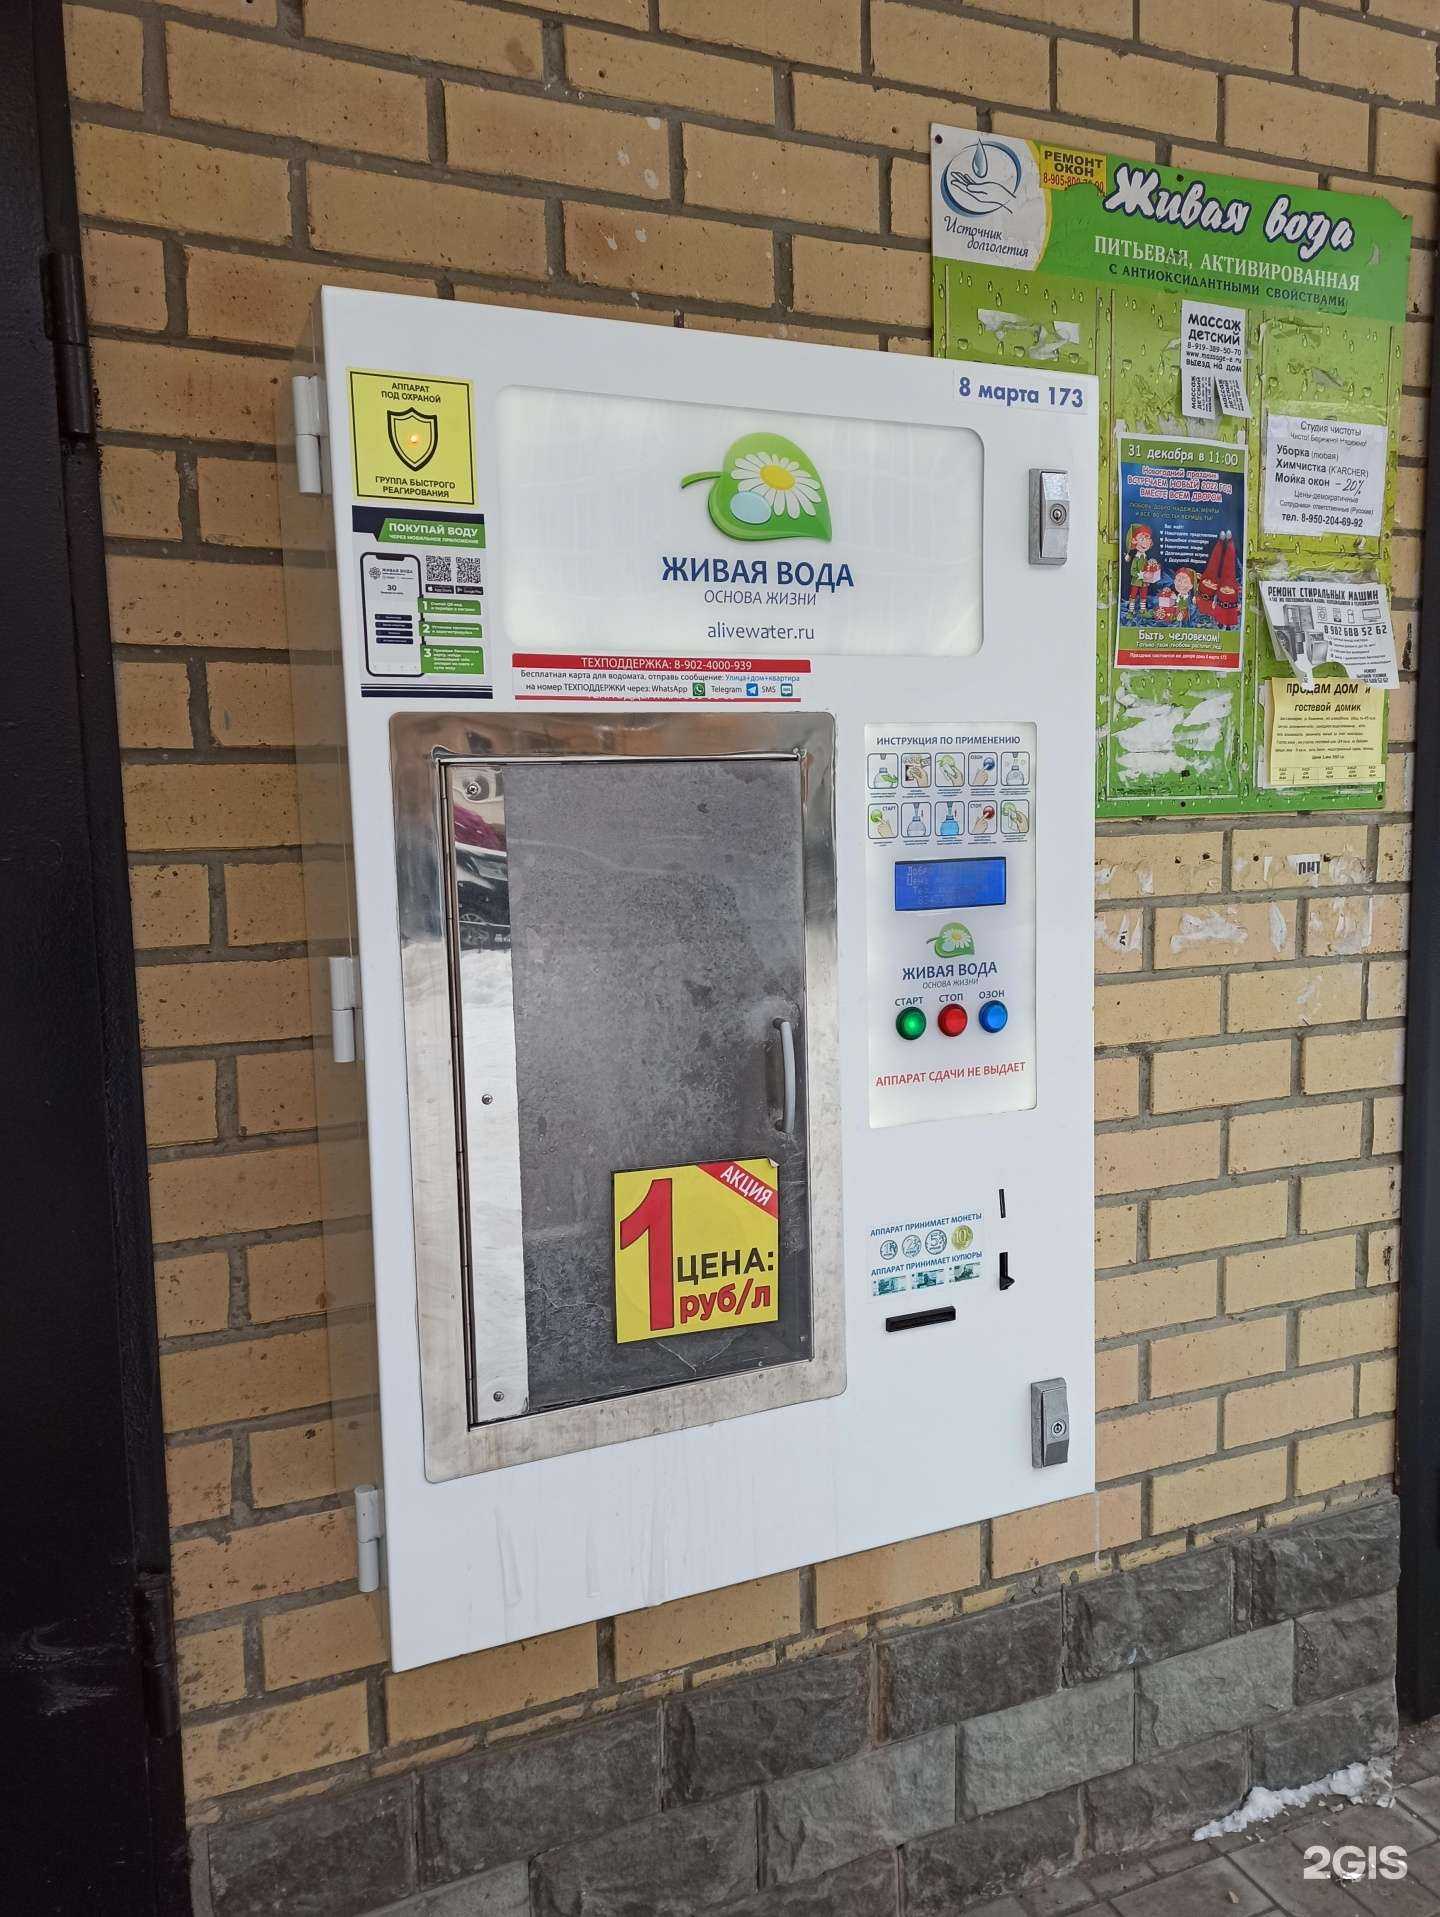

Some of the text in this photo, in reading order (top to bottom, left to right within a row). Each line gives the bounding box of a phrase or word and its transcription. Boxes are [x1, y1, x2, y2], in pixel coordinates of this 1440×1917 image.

[1044, 150, 1103, 168] РЕМОНТ
[1054, 163, 1094, 178] ОКОН
[1103, 165, 1355, 260] Живая вода
[943, 216, 1003, 241] Источник
[967, 233, 1029, 258] долголетия
[1094, 235, 1361, 291] ПИТЬЕВАЯ, АКТИВИРОВАННАЯ
[1109, 263, 1346, 307] С АНТИОКСИДАНТНЫМИ СВОЙСТВАМИ
[1188, 313, 1241, 331] массаж
[1188, 329, 1241, 346] детский
[1186, 359, 1241, 372] выезд на дом
[391, 383, 430, 393] АППАРАТ
[959, 377, 1083, 408] 8 марта 173
[381, 391, 441, 404] ПОД ОХРАНОЙ
[1300, 421, 1361, 436] Студия чистоты
[1128, 444, 1238, 466] 31 декабря в 11:00
[1276, 444, 1310, 460] Уборка
[1275, 458, 1369, 478] Химчистка (KARCHER)
[375, 475, 456, 489] ГРУППА БЫСТРОГО
[1275, 472, 1305, 485] Мойка
[1308, 477, 1330, 487] окон
[382, 486, 449, 498] РЕАГИРОВАНИЯ
[1282, 513, 1363, 527] тел. 8-950-204-69-92
[389, 523, 479, 539] ПОКУПАЙ ВОДУ
[661, 556, 854, 593] ЖИВАЯ ВОДА
[704, 589, 817, 606] ОСНОВА ЖИЗНИ
[1268, 586, 1297, 598] РЕМОНТ
[1300, 588, 1345, 600] СТИРАЛЬНЫХ
[1348, 590, 1379, 601] МАШИН
[422, 601, 428, 610] 1
[422, 624, 430, 633] 2
[707, 622, 815, 640] alivewater.ru
[1139, 629, 1220, 643] Быть человеком!
[1361, 627, 1372, 636] 52
[1376, 625, 1387, 635] 62
[423, 649, 431, 658] 3
[580, 657, 752, 671] ТЕХПОДДЕРЖКА: 8-902-4000-939
[520, 670, 567, 679] Бесплатная
[569, 673, 591, 681] карта
[592, 673, 607, 681] для
[648, 673, 679, 682] отправь
[563, 683, 626, 693] ТЕХПОДДЕРЖКИ
[651, 685, 688, 694] WhatsApp
[711, 685, 742, 694] Telegram
[1334, 683, 1359, 695] дом
[1295, 701, 1361, 712] гостевой домик
[876, 736, 1021, 747] ИНСТРУКЦИЯ ПО ПРИМЕНЕНИЮ
[902, 961, 997, 981] ЖИВАЯ ВОДА
[922, 977, 979, 989] ОСНОВА ЖИЗНИ
[894, 990, 1005, 1006] СТАРТ СТОП ОЗОН
[875, 1061, 1026, 1087] АППАРАТ СДАЧИ НЕ ВЫДАЕТ
[719, 1165, 773, 1206] АКЦИЯ
[870, 1213, 982, 1237] АППАРАТ ПРИНИМАЕТ МОНЕТЫ
[620, 1178, 675, 1331] 1
[677, 1247, 774, 1285] ЦЕНА:
[871, 1264, 904, 1277] АППАРАТ
[906, 1257, 950, 1271] ПРИНИМАЕТ
[951, 1251, 983, 1263] КУПЮРЫ
[679, 1278, 771, 1324] руб/л
